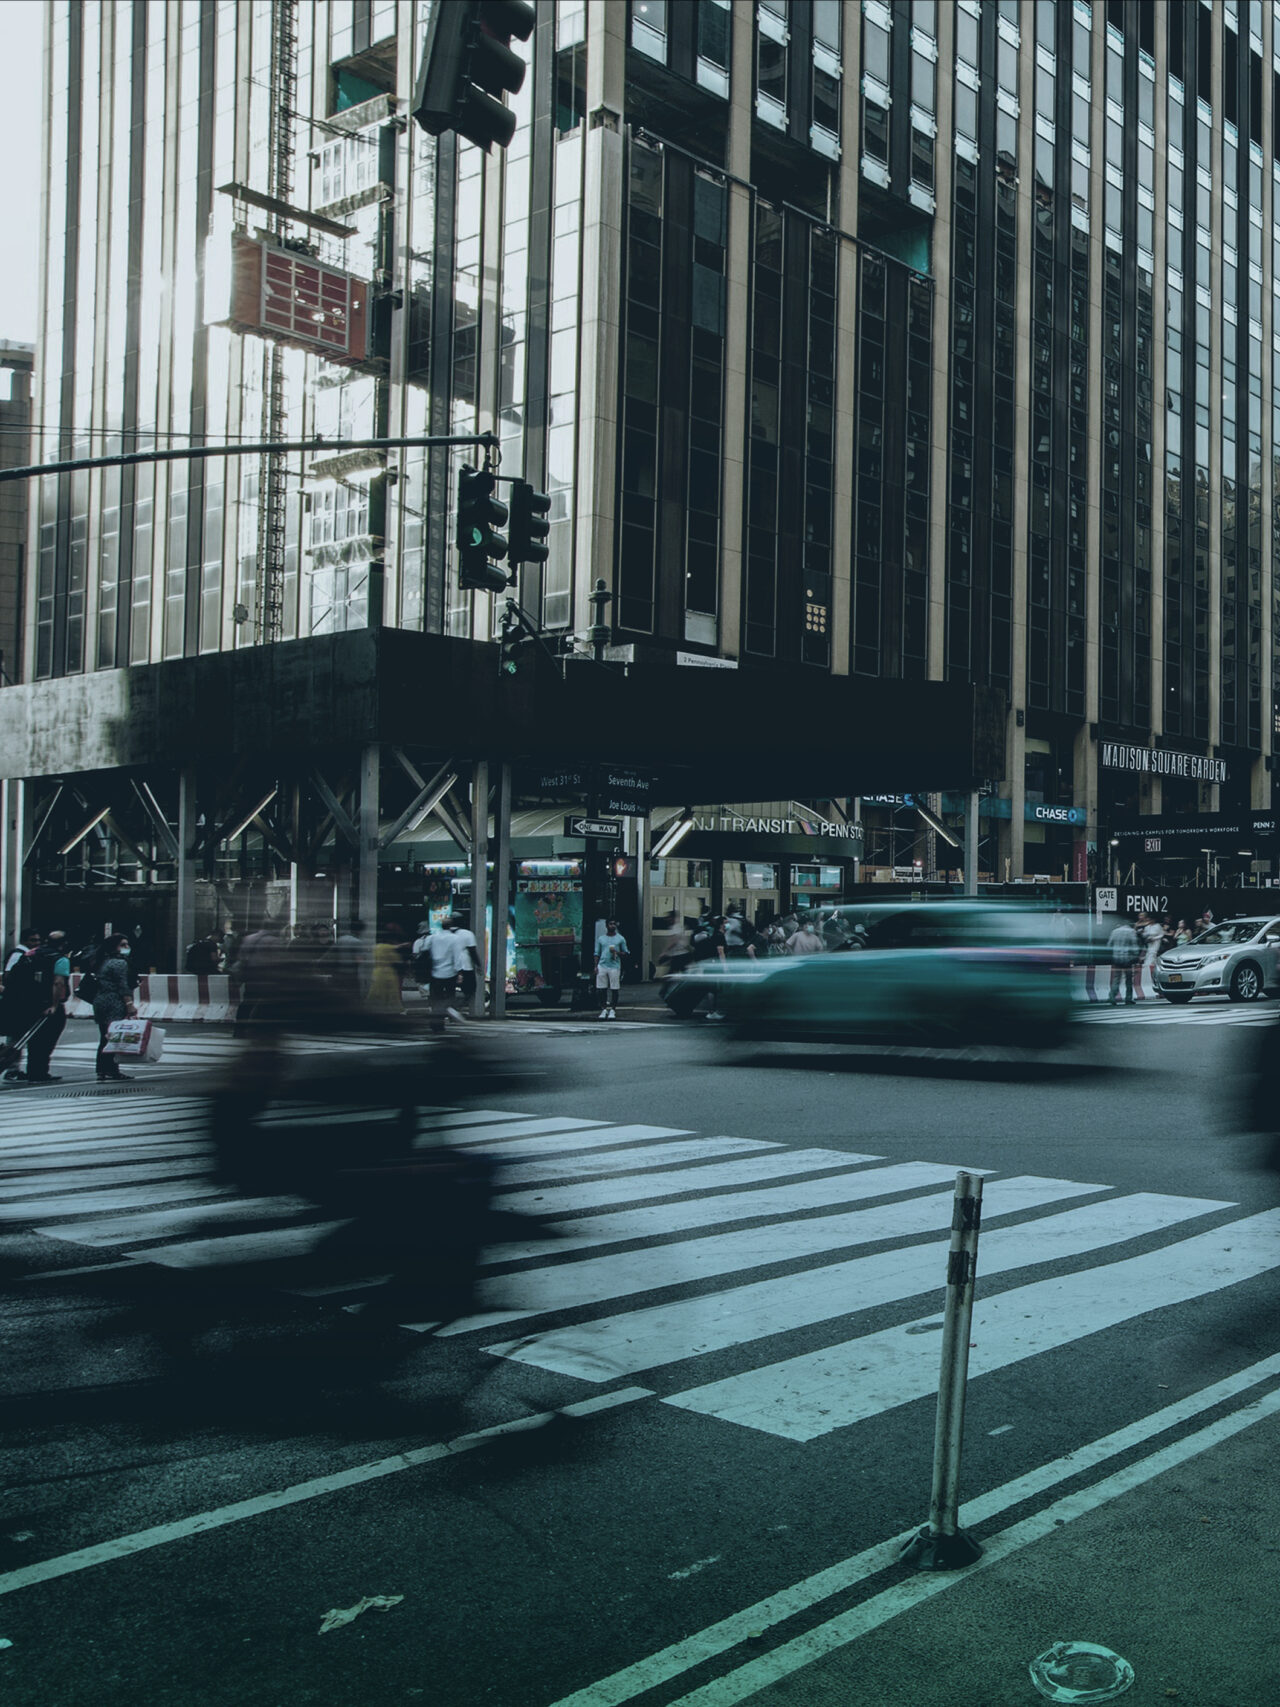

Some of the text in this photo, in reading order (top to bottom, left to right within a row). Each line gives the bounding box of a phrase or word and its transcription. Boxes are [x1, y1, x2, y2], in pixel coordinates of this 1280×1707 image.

[1102, 743, 1227, 782] MADISON SQUARE GARDEN
[608, 774, 650, 790] Seventh Ave
[609, 799, 619, 810] Joe
[620, 801, 636, 812] Louis
[1035, 807, 1068, 821] CHASE
[579, 823, 614, 833] ONE WAY
[692, 816, 714, 832] NJ
[719, 817, 796, 834] TRANSIT
[820, 821, 849, 838] PENN
[1252, 820, 1276, 829] PENN 2
[1145, 839, 1161, 851] EXIT
[1098, 890, 1115, 899] GATE
[1126, 895, 1169, 913] PENN 2
